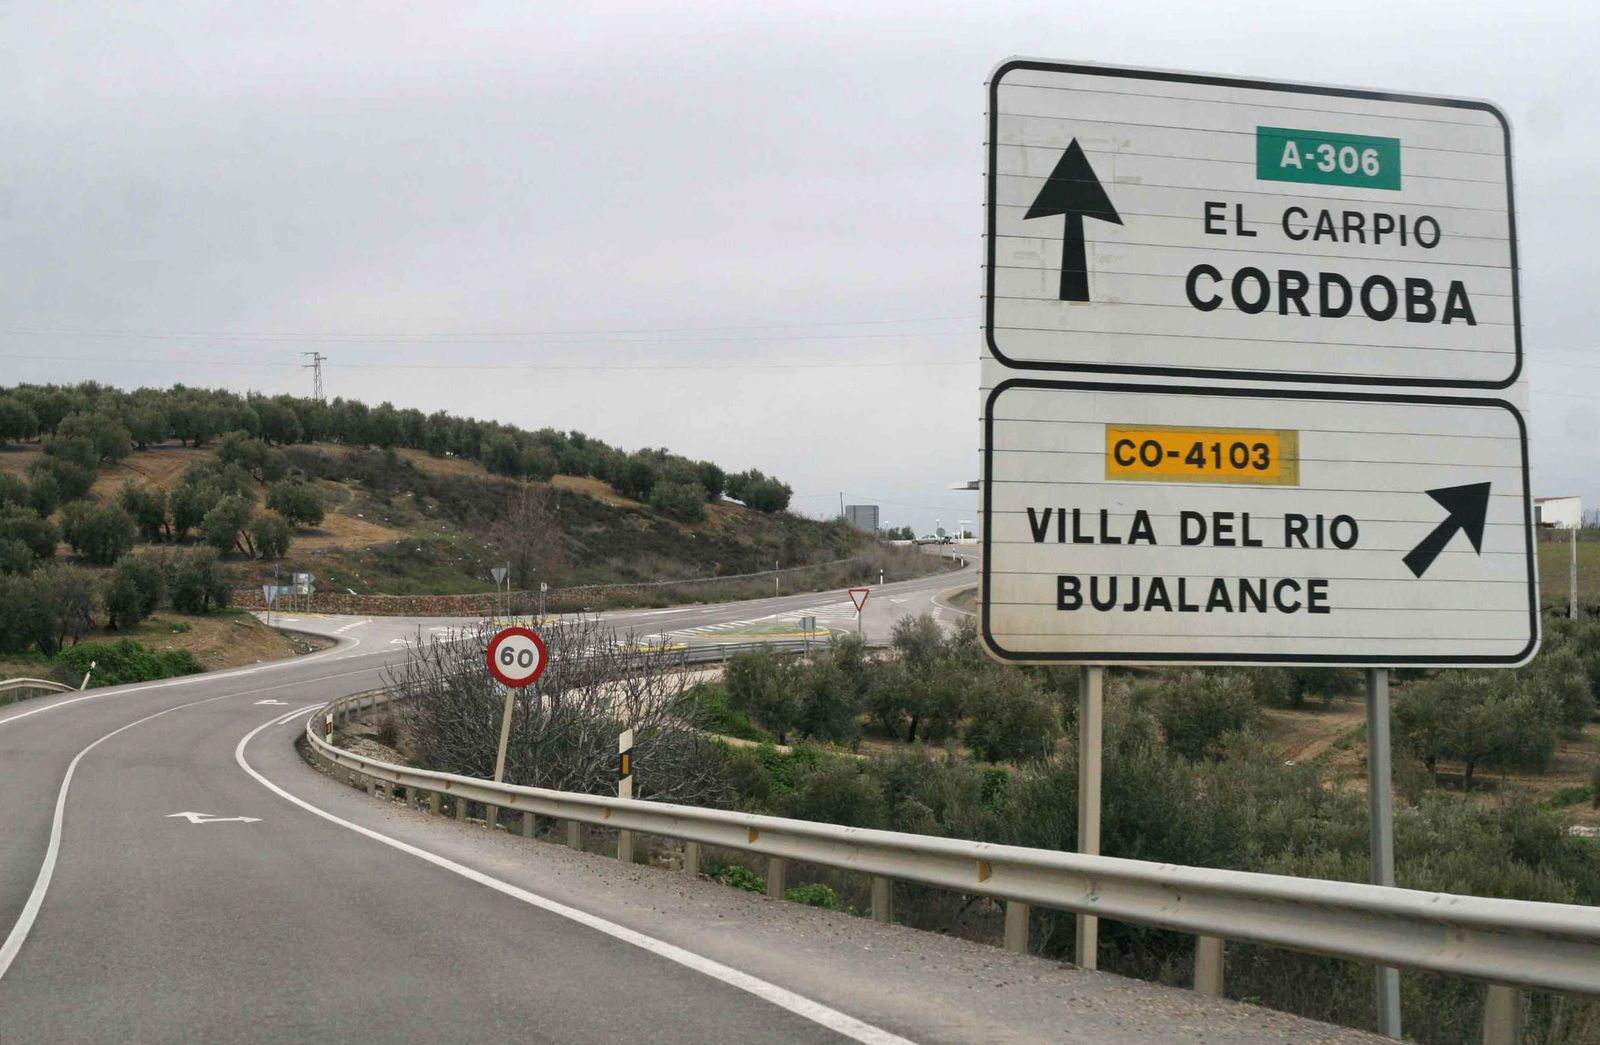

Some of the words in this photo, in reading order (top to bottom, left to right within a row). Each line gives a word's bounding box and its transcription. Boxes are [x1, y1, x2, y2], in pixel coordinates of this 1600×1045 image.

[1280, 140, 1380, 177] A-306
[1204, 201, 1257, 237] EL
[1281, 206, 1441, 249] CARPIO
[1185, 263, 1477, 326] CORDOBA
[1113, 438, 1271, 471] CO-4103
[1026, 507, 1158, 546] VILLA
[1180, 510, 1263, 548] DEL
[1284, 513, 1359, 551] RIO
[1055, 575, 1331, 614] BUJALANCE
[500, 646, 534, 669] 60
